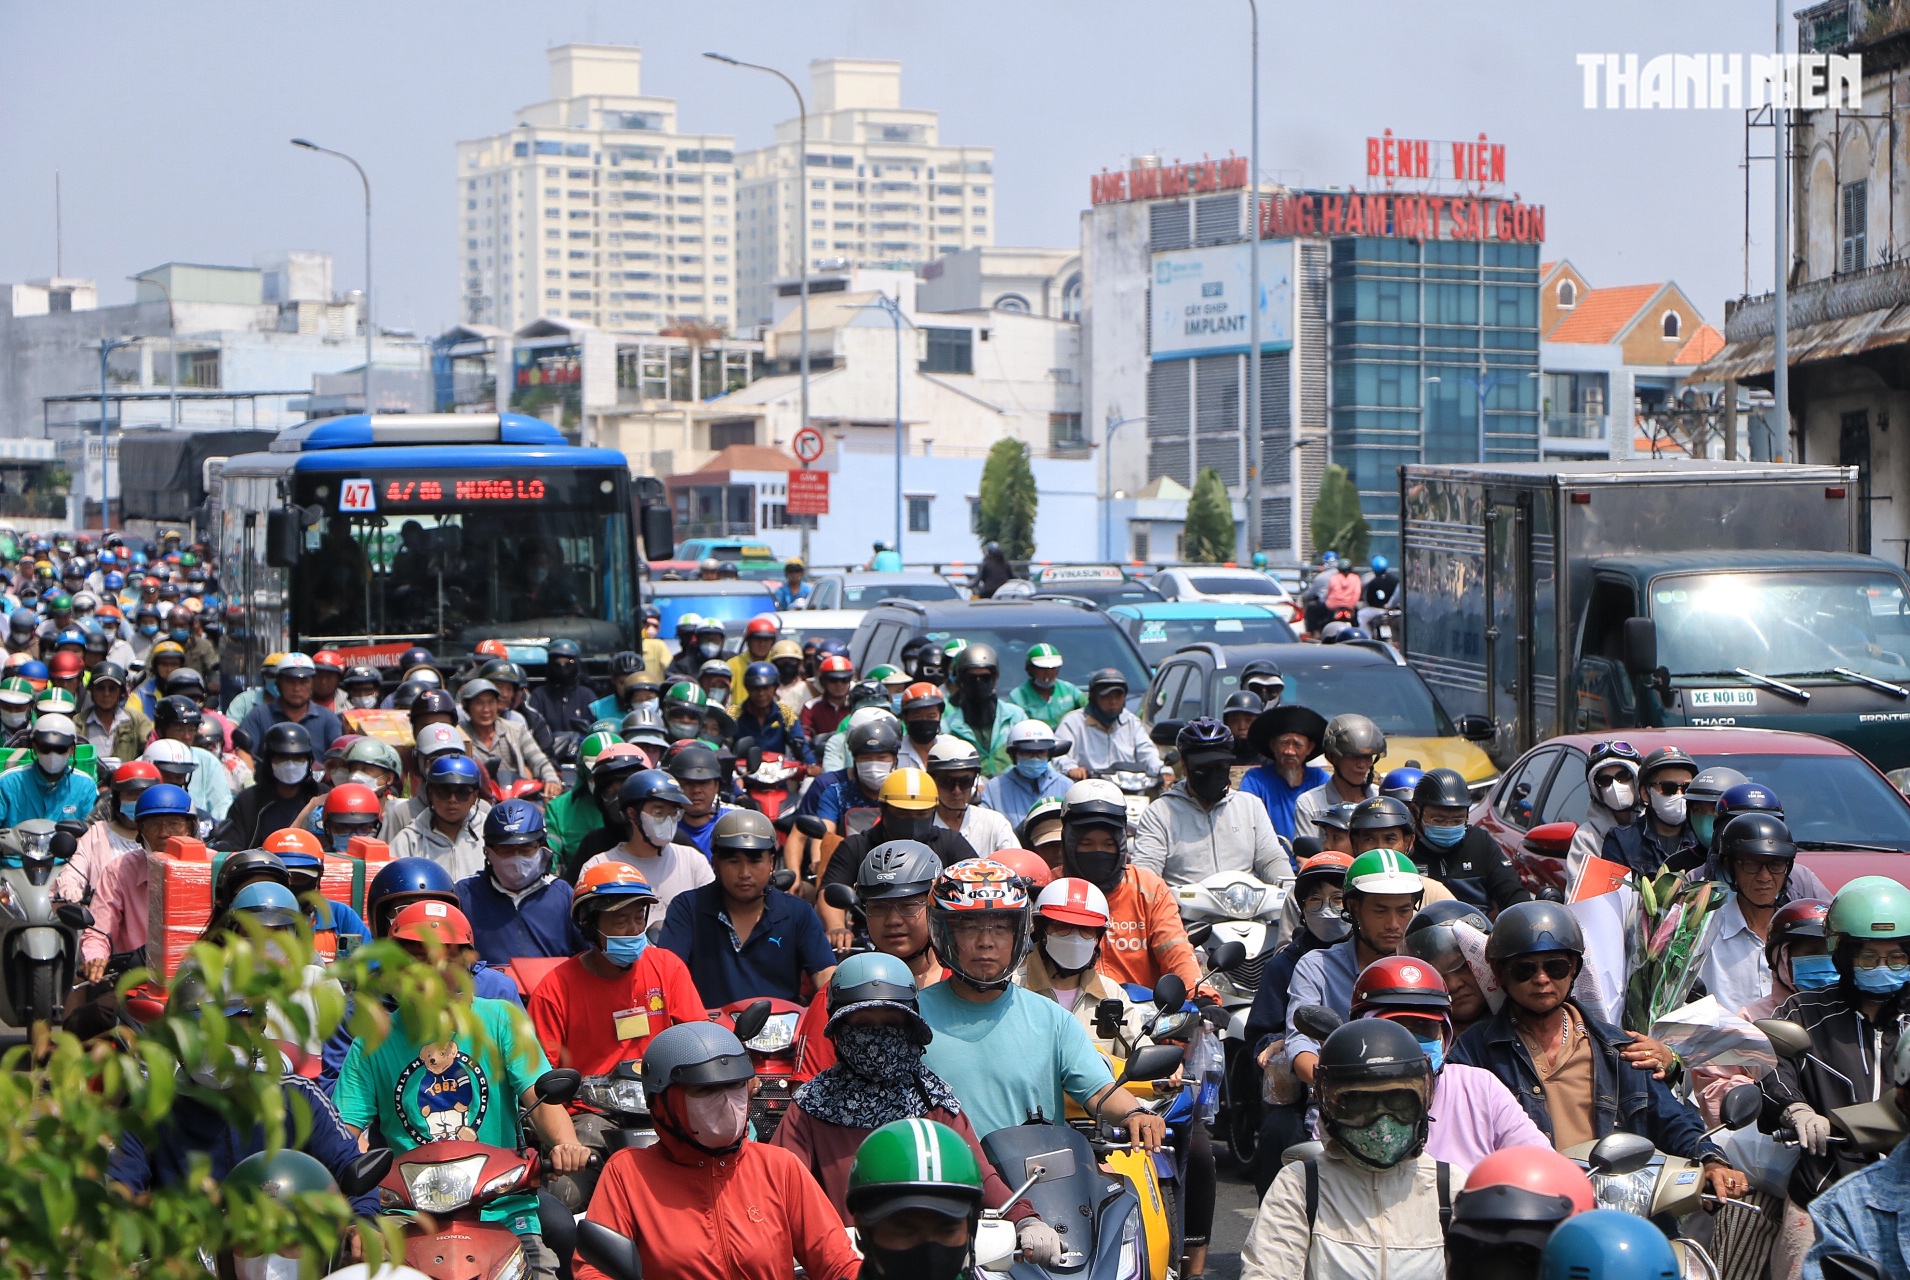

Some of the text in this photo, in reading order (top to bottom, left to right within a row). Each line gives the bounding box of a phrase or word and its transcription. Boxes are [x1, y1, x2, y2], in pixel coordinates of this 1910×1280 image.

[1367, 128, 1505, 191] BỆNH VIỆN
[1322, 185, 1388, 237] HÀM
[1394, 192, 1443, 245] MẶT
[1451, 191, 1490, 240] SÀI
[1496, 192, 1546, 243] GÒN
[1185, 314, 1246, 335] IMPLANT
[344, 485, 370, 507] 47
[1694, 690, 1754, 704] XE NỘI BỘ
[1692, 717, 1735, 726] THACO
[877, 872, 897, 880] GRS
[971, 889, 1003, 899] KYT
[428, 1081, 457, 1096] 1982
